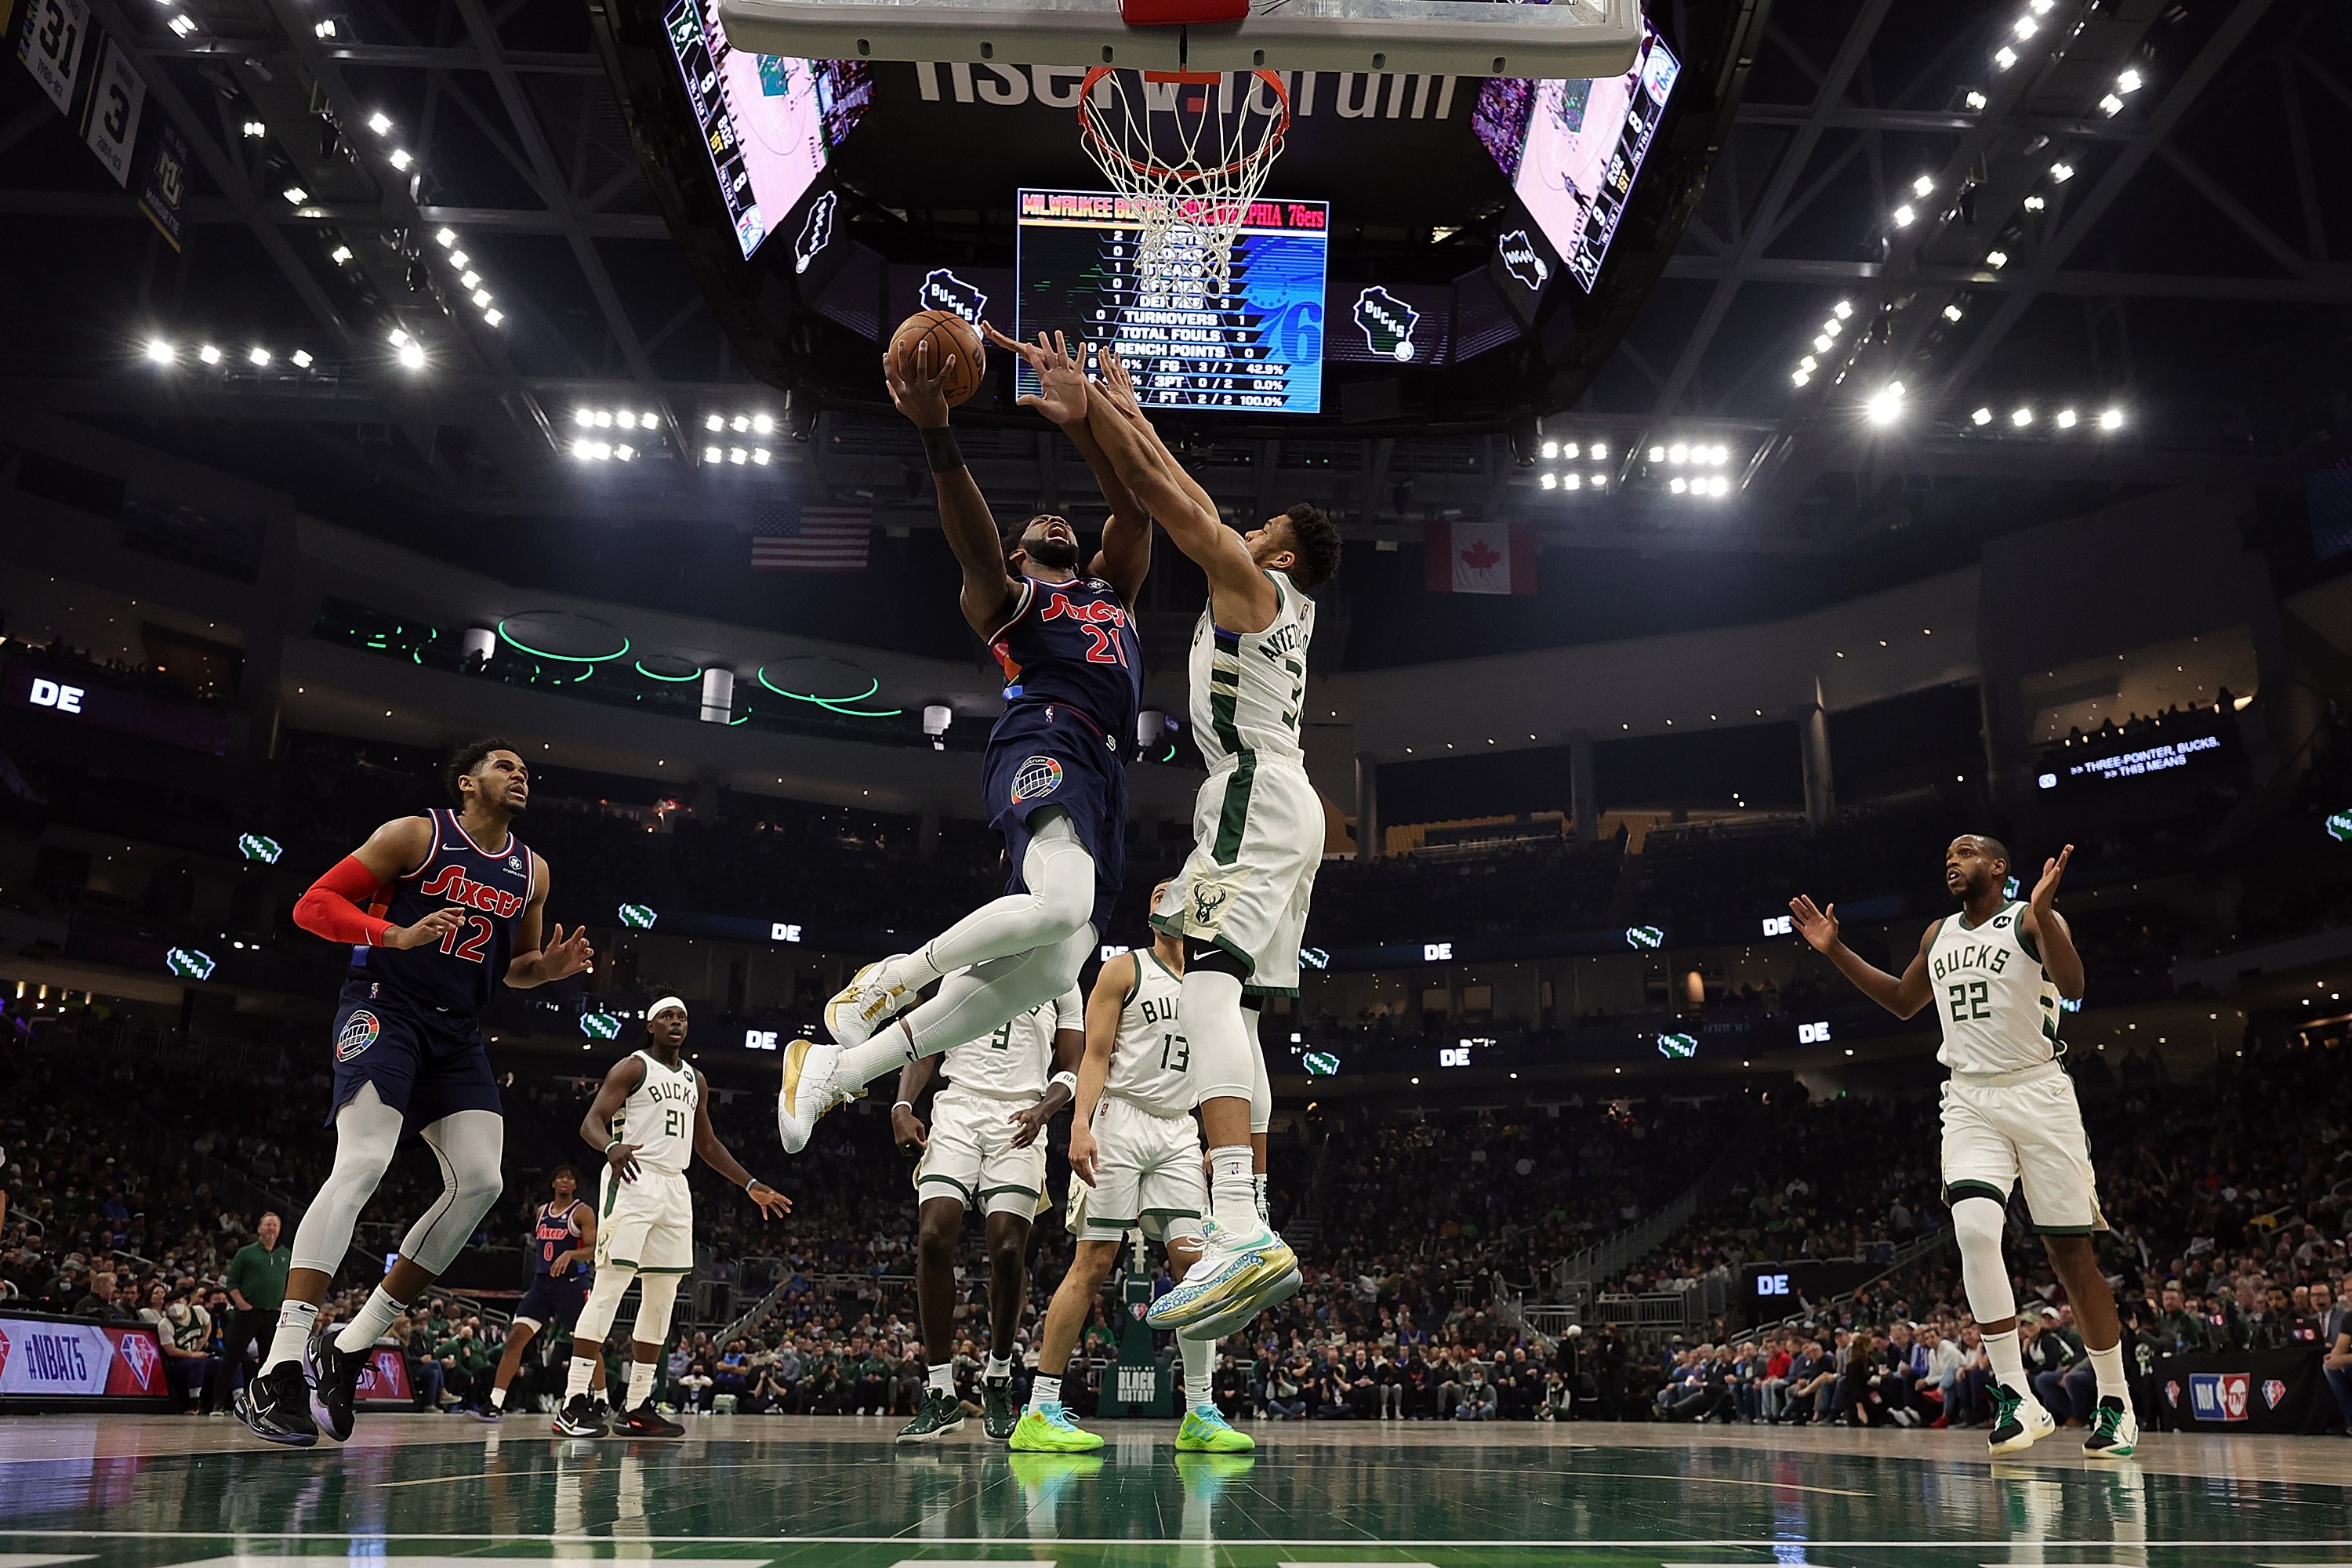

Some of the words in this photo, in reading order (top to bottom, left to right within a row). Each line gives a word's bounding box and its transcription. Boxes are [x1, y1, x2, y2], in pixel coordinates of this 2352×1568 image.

[39, 1, 76, 78] 31
[700, 71, 716, 93] 9
[104, 84, 129, 143] 3
[1628, 111, 1643, 133] 8
[717, 115, 735, 149] 8:02
[1606, 154, 1624, 187] 8:02
[1617, 169, 1631, 194] 1ST
[733, 172, 747, 192] 8
[1022, 194, 1112, 219] MILWAUKEE
[1287, 205, 1325, 227] 76ers
[1592, 205, 1606, 227] 9
[1113, 230, 1123, 241] 2
[1113, 246, 1123, 256] 0
[1114, 262, 1121, 272] 1
[1112, 278, 1122, 289] 0
[1221, 282, 1230, 293] 2
[931, 283, 973, 321] BUCKS
[1113, 294, 1121, 304] 1
[1220, 299, 1229, 308] 3
[1096, 310, 1105, 319] 0
[1124, 311, 1218, 325] TURNOVERS
[1239, 315, 1245, 325] 1
[1365, 300, 1405, 337] BUCKS
[1097, 326, 1104, 336] 1
[1120, 327, 1168, 340] TOTAL
[1171, 328, 1221, 342] FOULS
[1236, 332, 1246, 342] 3
[1087, 342, 1097, 352] 0
[1115, 342, 1168, 355] BENCH
[1170, 345, 1225, 358] POINTS
[1244, 348, 1254, 358] 0
[1160, 360, 1180, 372] FG
[1198, 362, 1208, 372] 3
[1224, 363, 1233, 372] 7
[1246, 363, 1284, 376] 42.9%
[1154, 376, 1184, 388] 3PT
[1198, 378, 1207, 388] 0
[1223, 379, 1233, 389] 2
[1253, 379, 1283, 391] 0.0%
[1160, 391, 1179, 404] FT
[1197, 394, 1207, 405] 2
[1223, 395, 1232, 405] 2
[1240, 395, 1283, 407] 100.0%
[1040, 593, 1125, 628] Sixers
[1080, 623, 1128, 670] 21
[30, 678, 85, 713] DE
[1281, 658, 1302, 732] 3
[2118, 762, 2146, 777] THIS
[2147, 753, 2187, 771] MEANS
[247, 835, 273, 862] BUCKS
[503, 866, 527, 880] crypto.com
[420, 865, 523, 918] Sixers
[771, 923, 801, 942] DE
[1762, 915, 1792, 936] DE
[1424, 943, 1452, 960] DE
[175, 949, 204, 978] BUCKS
[1934, 945, 2011, 981] BUCKS
[1949, 981, 1991, 1022] 22
[746, 1030, 778, 1050] DE
[1798, 1022, 1831, 1044] DE
[1160, 1034, 1190, 1073] 13
[1440, 1048, 1470, 1067] DE
[648, 1082, 698, 1111] BUCKS
[665, 1109, 684, 1138] 21
[543, 1241, 554, 1261] 0
[1757, 1274, 1790, 1296] DE
[25, 1334, 86, 1381] #NBA75
[1118, 1371, 1156, 1390] BLACK
[1117, 1389, 1155, 1403] HISTORY
